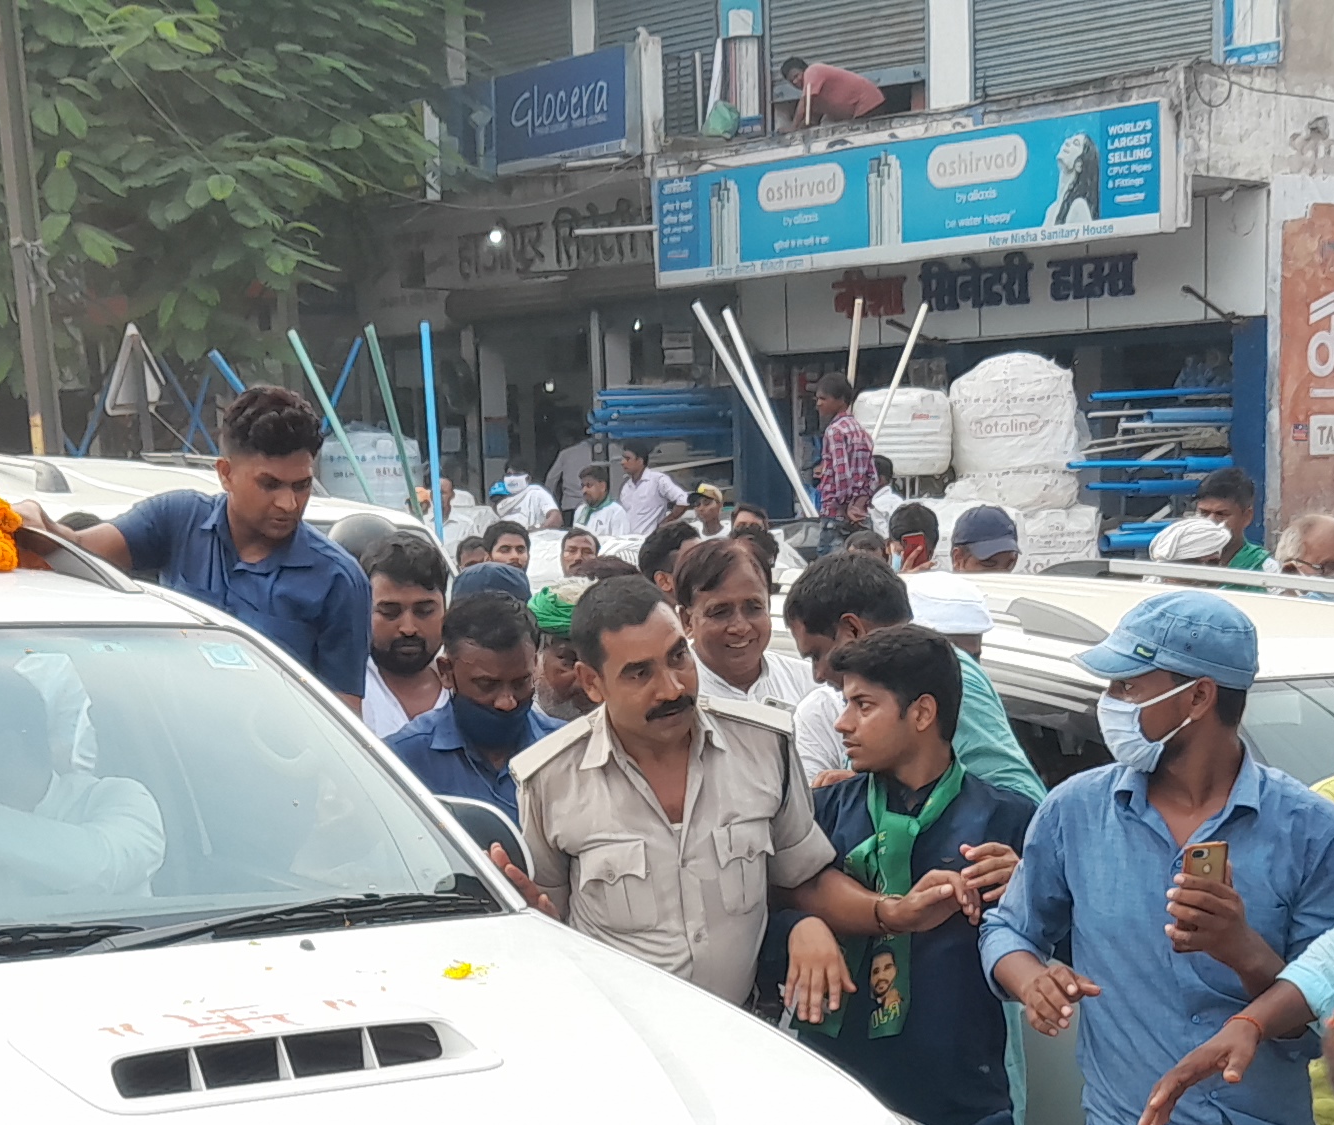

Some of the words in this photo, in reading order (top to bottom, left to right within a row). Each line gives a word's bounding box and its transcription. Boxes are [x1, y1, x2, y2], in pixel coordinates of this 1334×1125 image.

[511, 80, 608, 138] Glocera
[1107, 119, 1152, 136] WORLD'S
[1107, 133, 1152, 150] LARGEST
[936, 145, 1017, 178] ashirvad
[1107, 147, 1152, 164] SELLING
[1107, 164, 1129, 176] CPVC
[766, 172, 836, 202] ashirvad
[1115, 177, 1144, 189] Fittings
[956, 193, 967, 204] by
[958, 214, 982, 228] water
[989, 235, 1009, 247] New
[1011, 231, 1038, 244] Nisha
[1040, 227, 1080, 242] Sanitary
[1082, 222, 1114, 235] House
[1047, 252, 1138, 302] हाउस
[973, 419, 1038, 435] Rotoline
